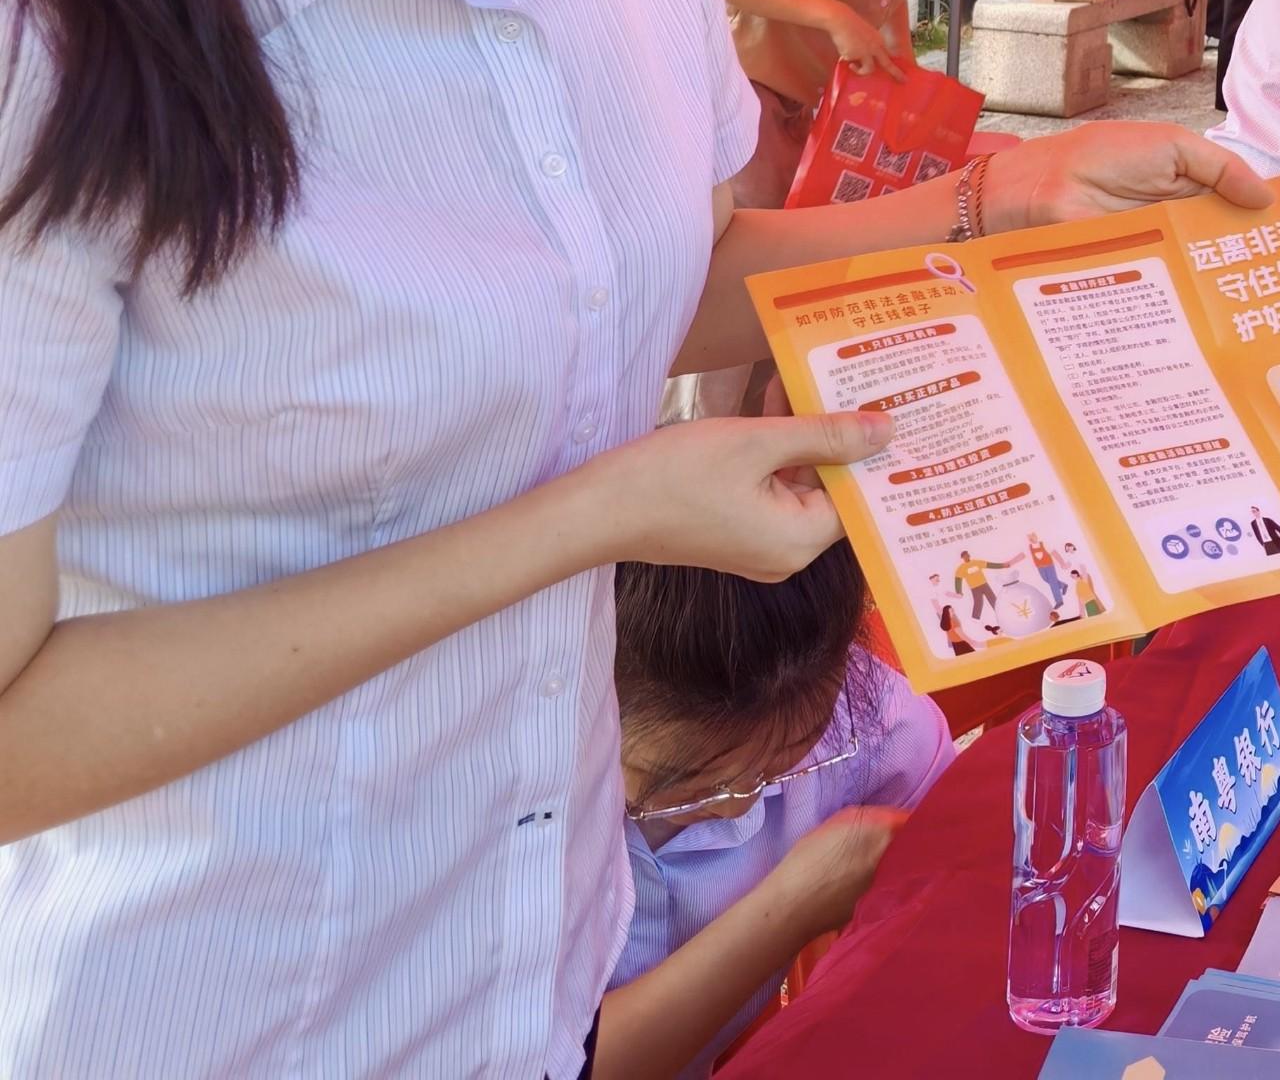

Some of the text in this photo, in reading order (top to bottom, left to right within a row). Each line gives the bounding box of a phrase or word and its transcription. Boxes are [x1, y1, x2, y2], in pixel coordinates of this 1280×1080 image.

[852, 301, 932, 329] 守住钱袋子
[1187, 699, 1280, 854] 南粤银行
